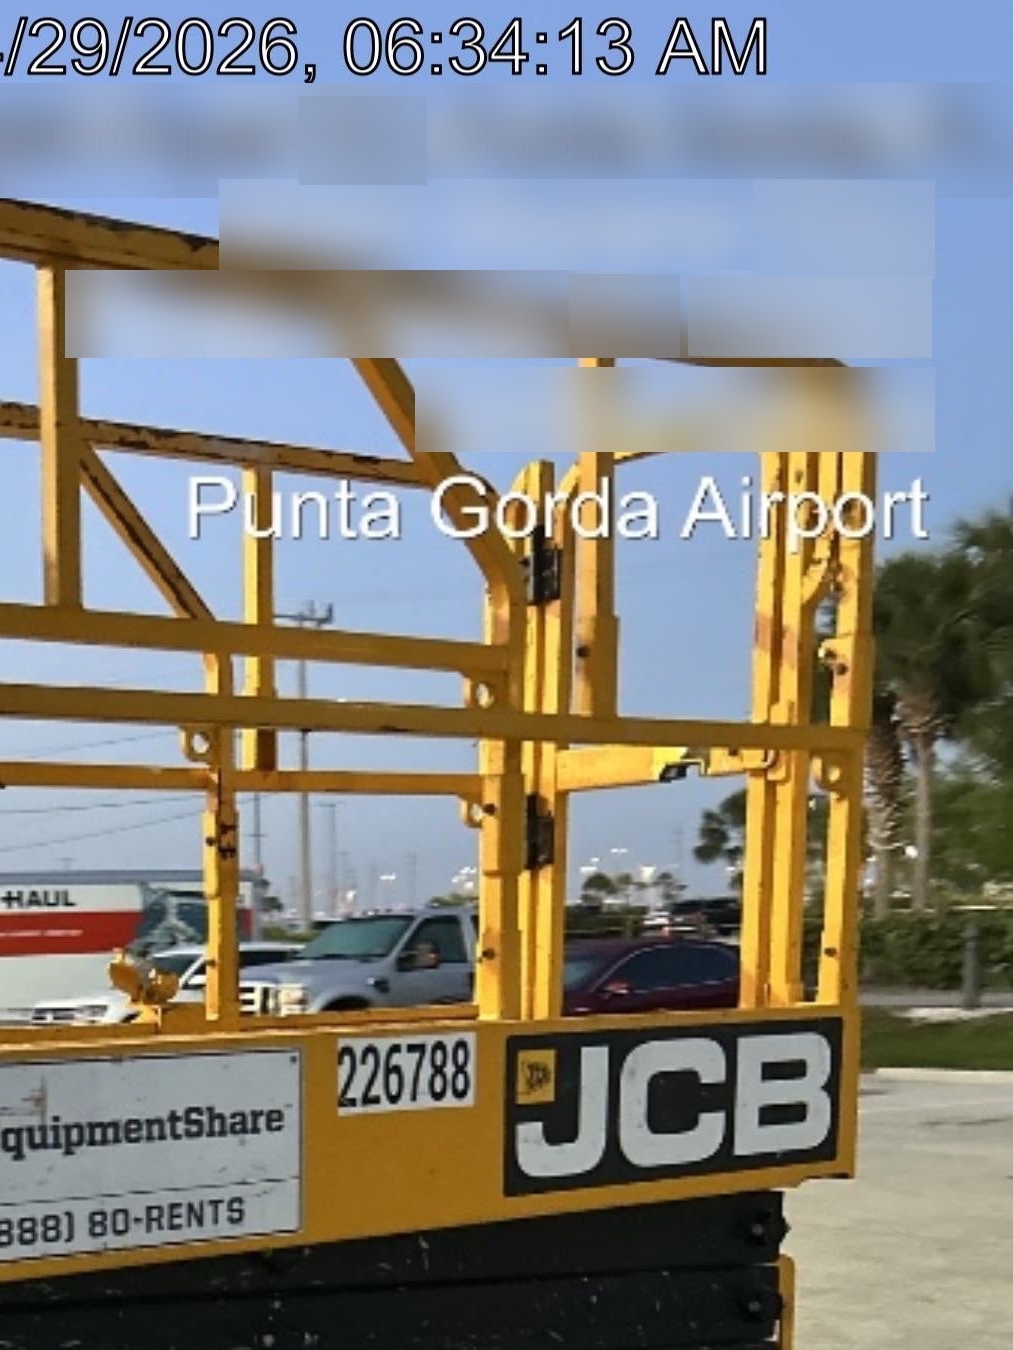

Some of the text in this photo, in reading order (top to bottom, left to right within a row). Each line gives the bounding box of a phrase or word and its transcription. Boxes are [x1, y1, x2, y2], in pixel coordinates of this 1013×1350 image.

[337, 1038, 471, 1108] 226788
[515, 1031, 833, 1179] JCB
[87, 1195, 247, 1239] 80-RENTS
